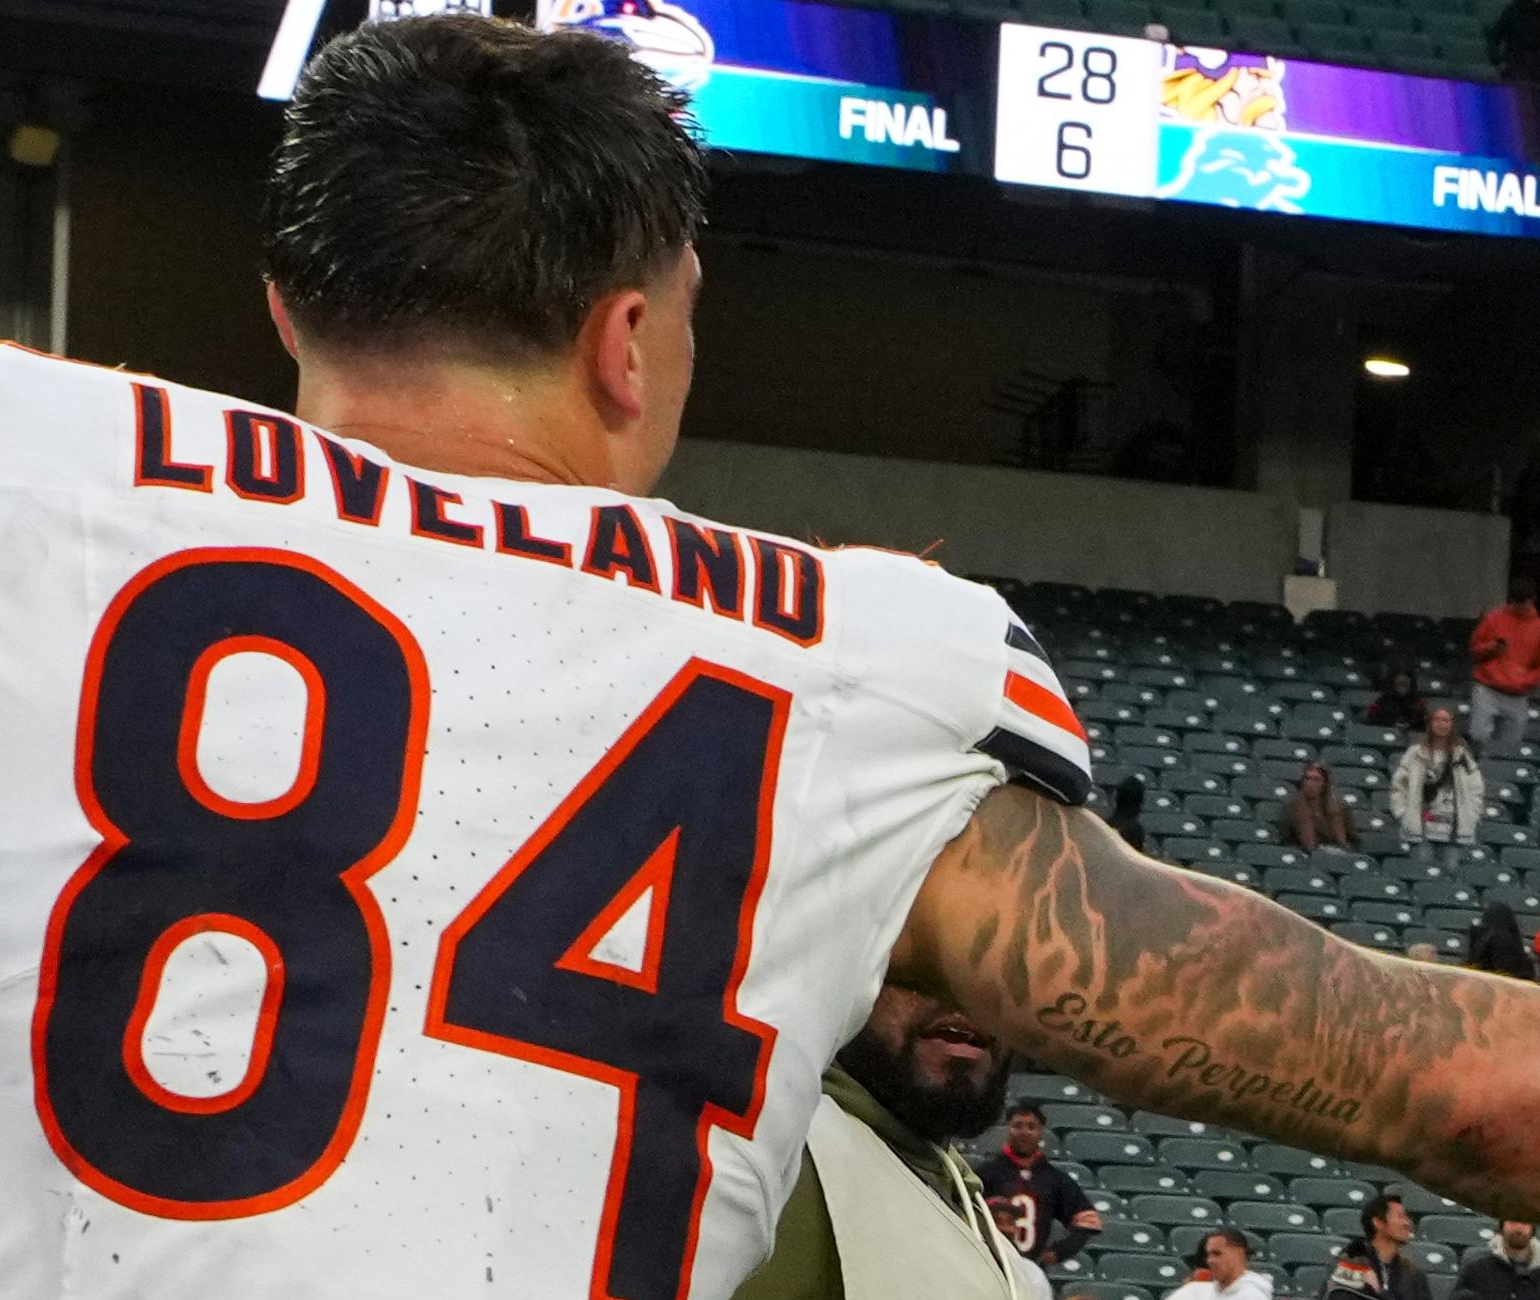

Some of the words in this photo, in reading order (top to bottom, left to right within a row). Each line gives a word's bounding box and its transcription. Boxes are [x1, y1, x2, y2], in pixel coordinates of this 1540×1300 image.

[1038, 41, 1118, 106] 28
[838, 96, 961, 153] FINAL
[1055, 121, 1093, 179] 6
[131, 382, 826, 649] LOVELAND
[1035, 992, 1139, 1059] Esto
[1161, 1036, 1362, 1123] Perpetua
